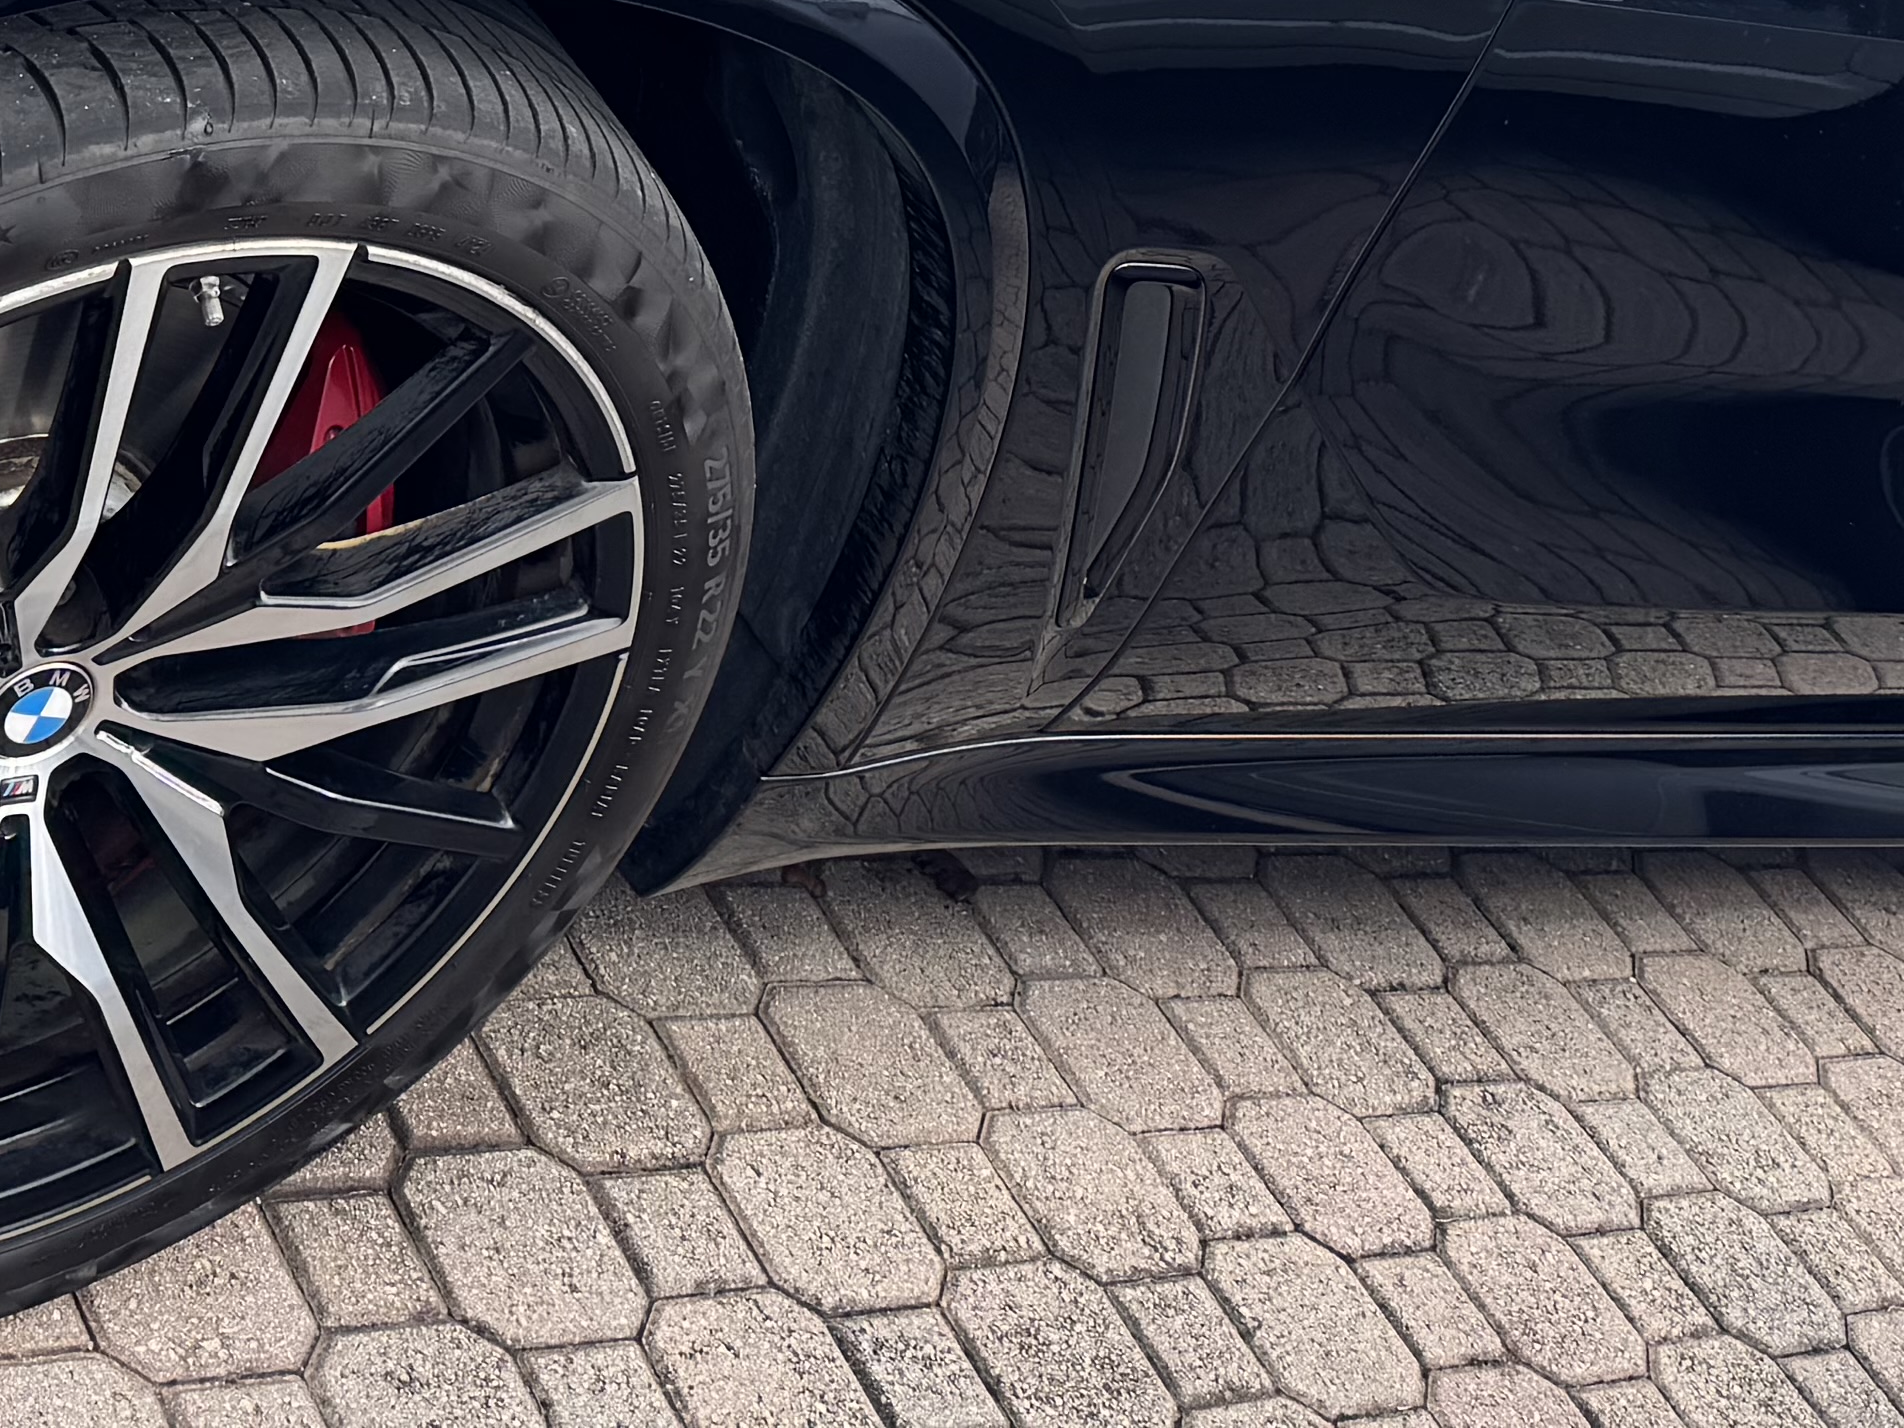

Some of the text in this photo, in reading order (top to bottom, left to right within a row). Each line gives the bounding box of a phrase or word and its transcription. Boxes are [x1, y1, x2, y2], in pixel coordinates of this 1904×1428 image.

[704, 446, 733, 567] 275/35
[701, 571, 727, 604] R
[691, 600, 722, 651] 22
[13, 669, 91, 704] BMW
